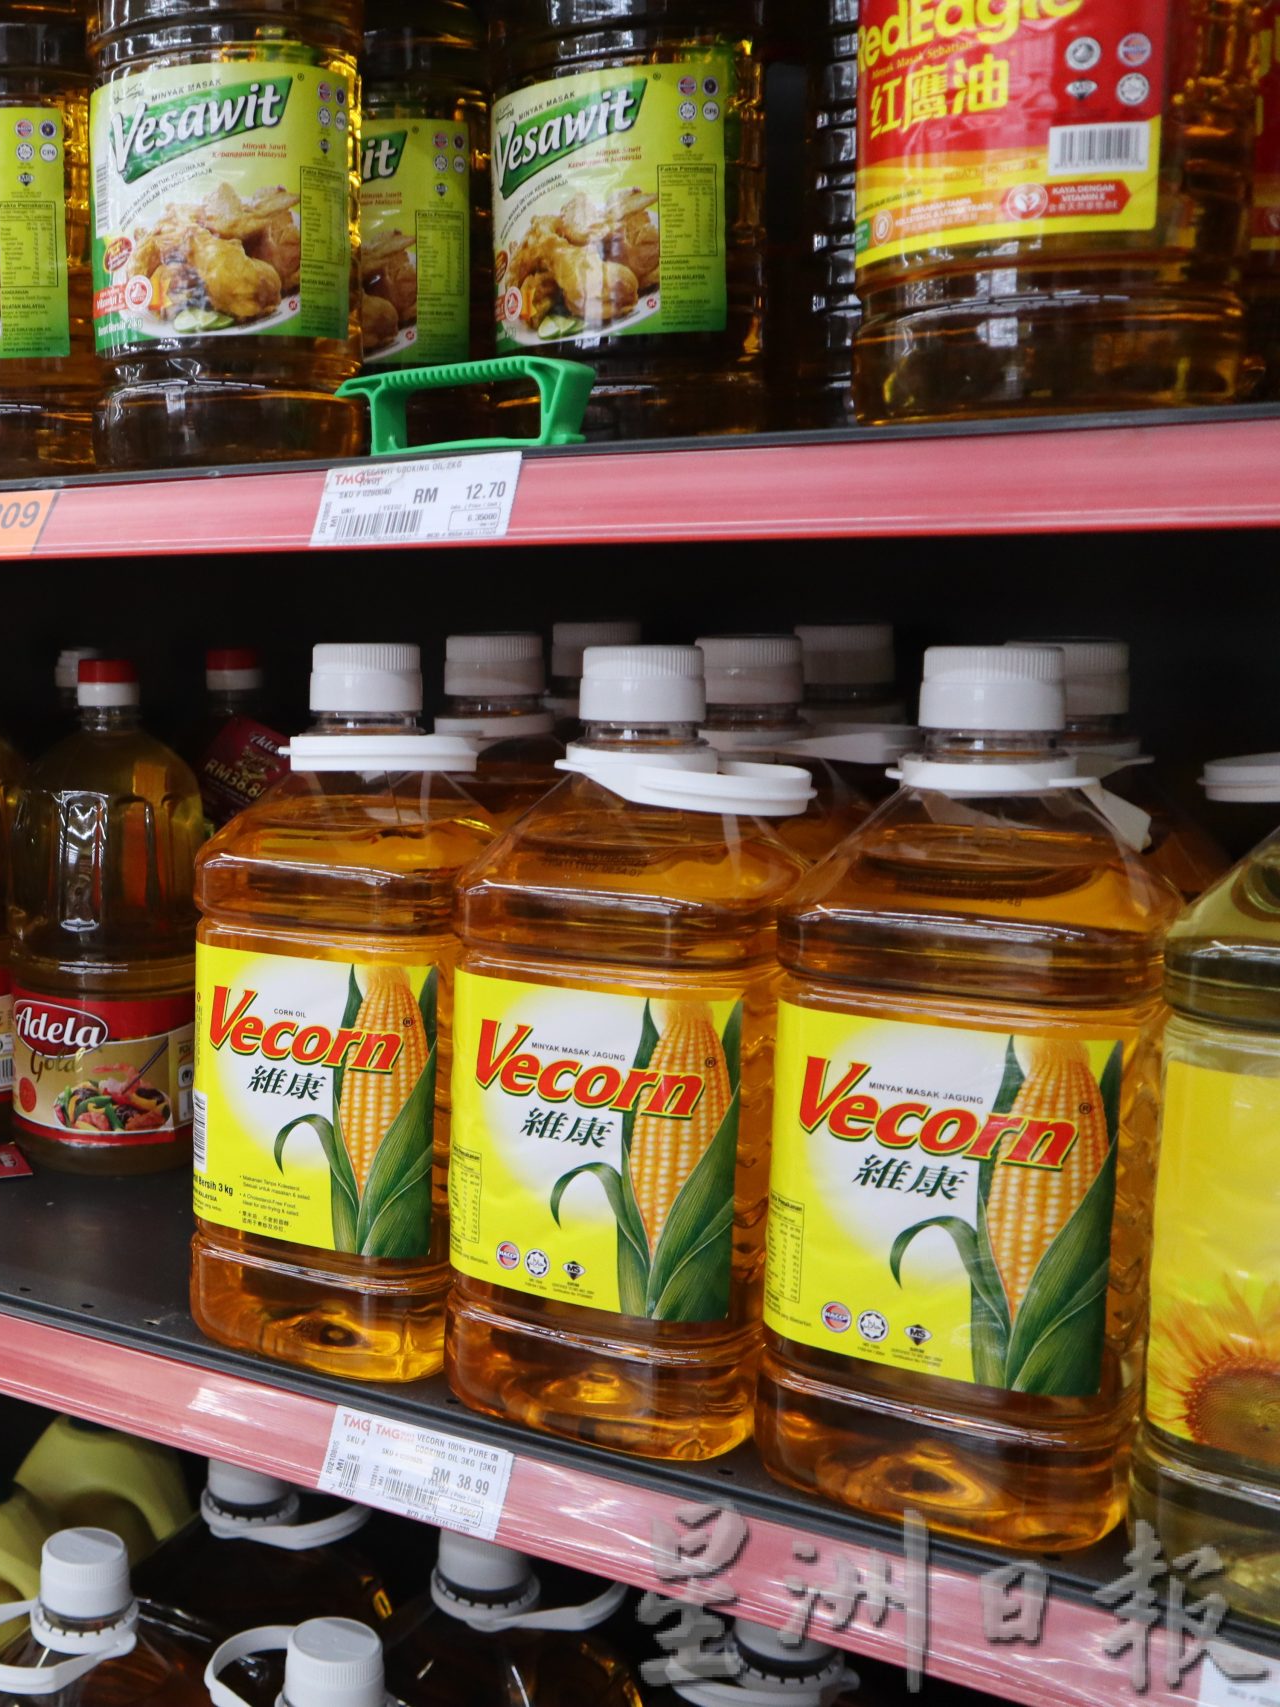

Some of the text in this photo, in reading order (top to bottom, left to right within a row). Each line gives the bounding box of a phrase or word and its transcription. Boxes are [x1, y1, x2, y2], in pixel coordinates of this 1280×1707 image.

[151, 79, 222, 102] MINYAK MASAK
[518, 91, 576, 120] MINYAK MASAK
[111, 83, 282, 173] Vesawit
[494, 89, 635, 189] Vesawit
[396, 464, 430, 475] COOKING
[413, 481, 507, 503] RM 12.70
[16, 1006, 102, 1048] Adela
[273, 1007, 307, 1019] CORN OIL
[209, 986, 405, 1075] Vecorn
[531, 1041, 626, 1062] MINYAK MASAK JAGUNG
[247, 1065, 327, 1101] 維康
[475, 1018, 706, 1121] Vecorn
[868, 1081, 985, 1105] MINYAK MASAK JAGUNG
[520, 1107, 614, 1149] 維康
[799, 1055, 1079, 1172] Vecorn
[199, 1176, 217, 1191] Bersih
[225, 1184, 234, 1197] kg
[852, 1153, 969, 1201] 維康
[346, 1434, 360, 1445] SKU
[376, 1424, 400, 1440] TMG
[417, 1433, 445, 1448] VECORN
[469, 1447, 488, 1459] PURE
[347, 1453, 360, 1463] UNIT
[415, 1444, 475, 1468] COOKING OIL 3KG
[431, 1466, 490, 1496] RM 38.99
